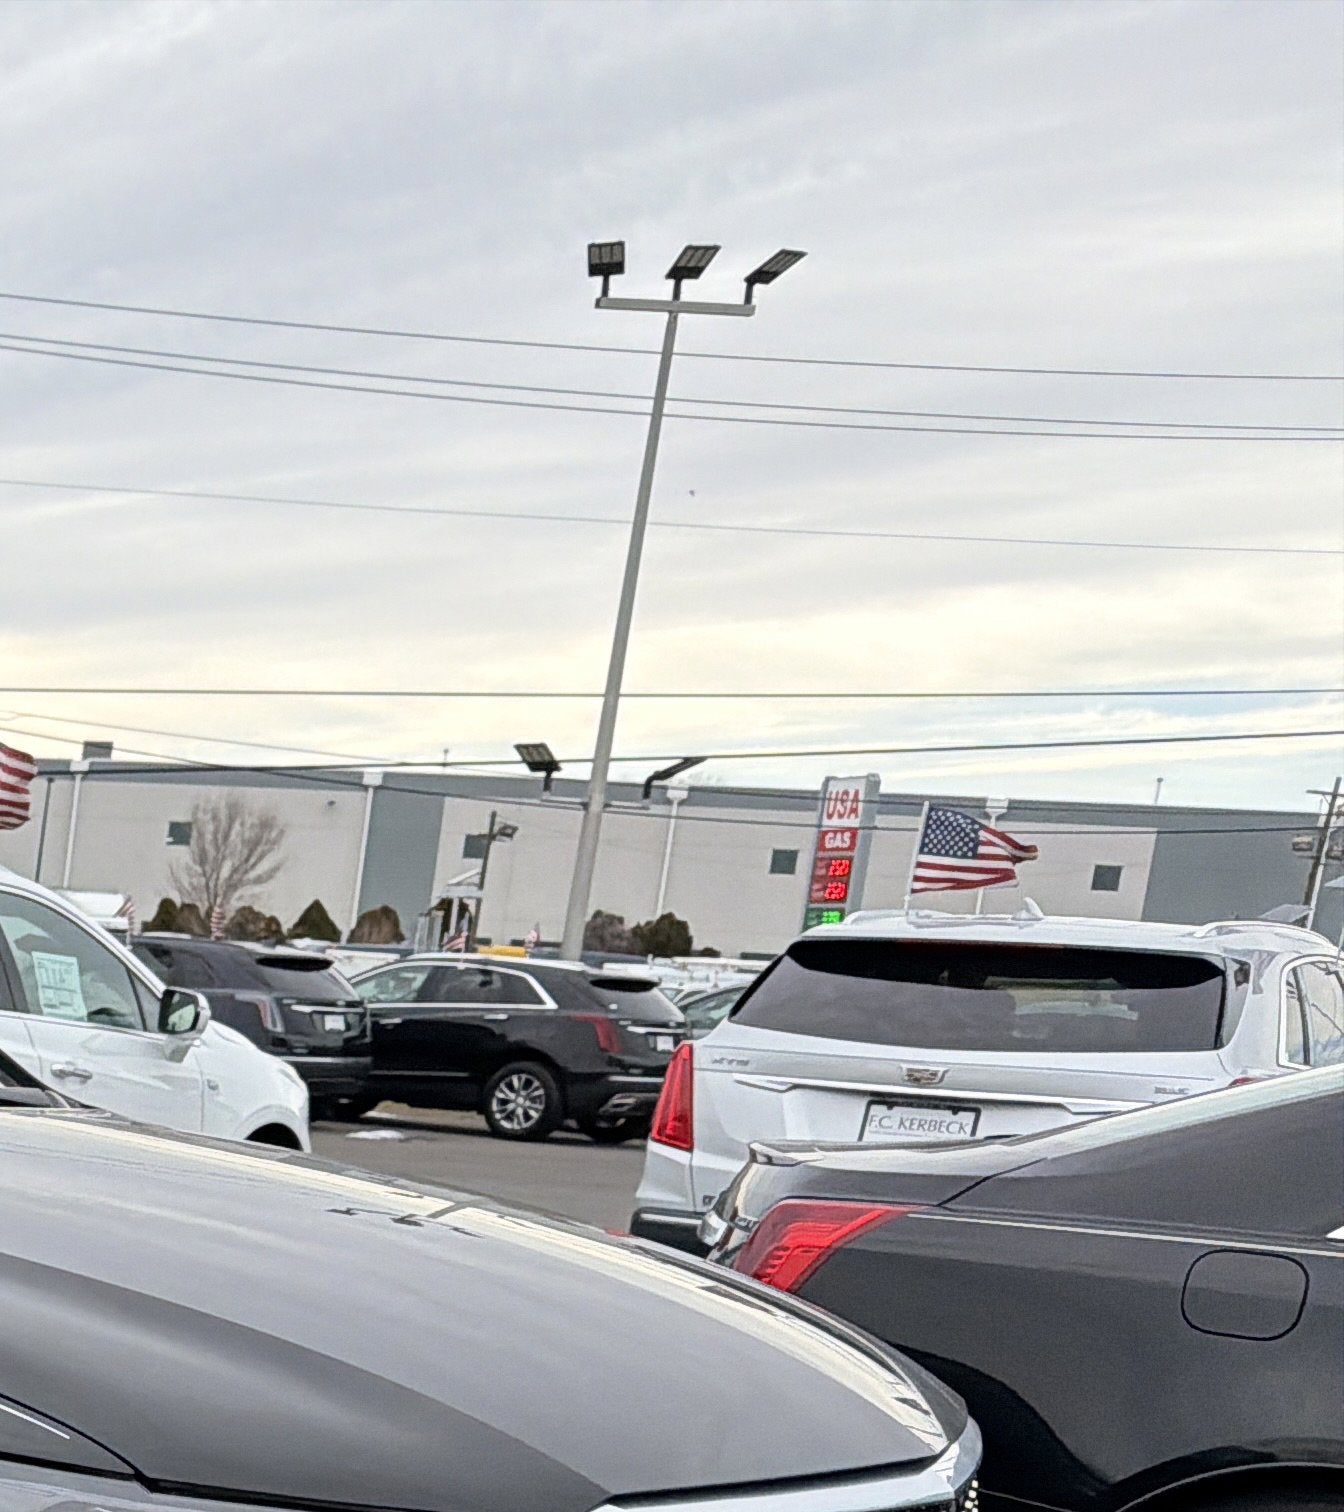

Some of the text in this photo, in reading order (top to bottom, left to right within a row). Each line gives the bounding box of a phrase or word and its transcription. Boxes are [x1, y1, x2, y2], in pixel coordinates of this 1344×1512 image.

[826, 788, 861, 821] USA
[824, 831, 851, 849] GAS
[897, 1116, 970, 1136] KERBECK
